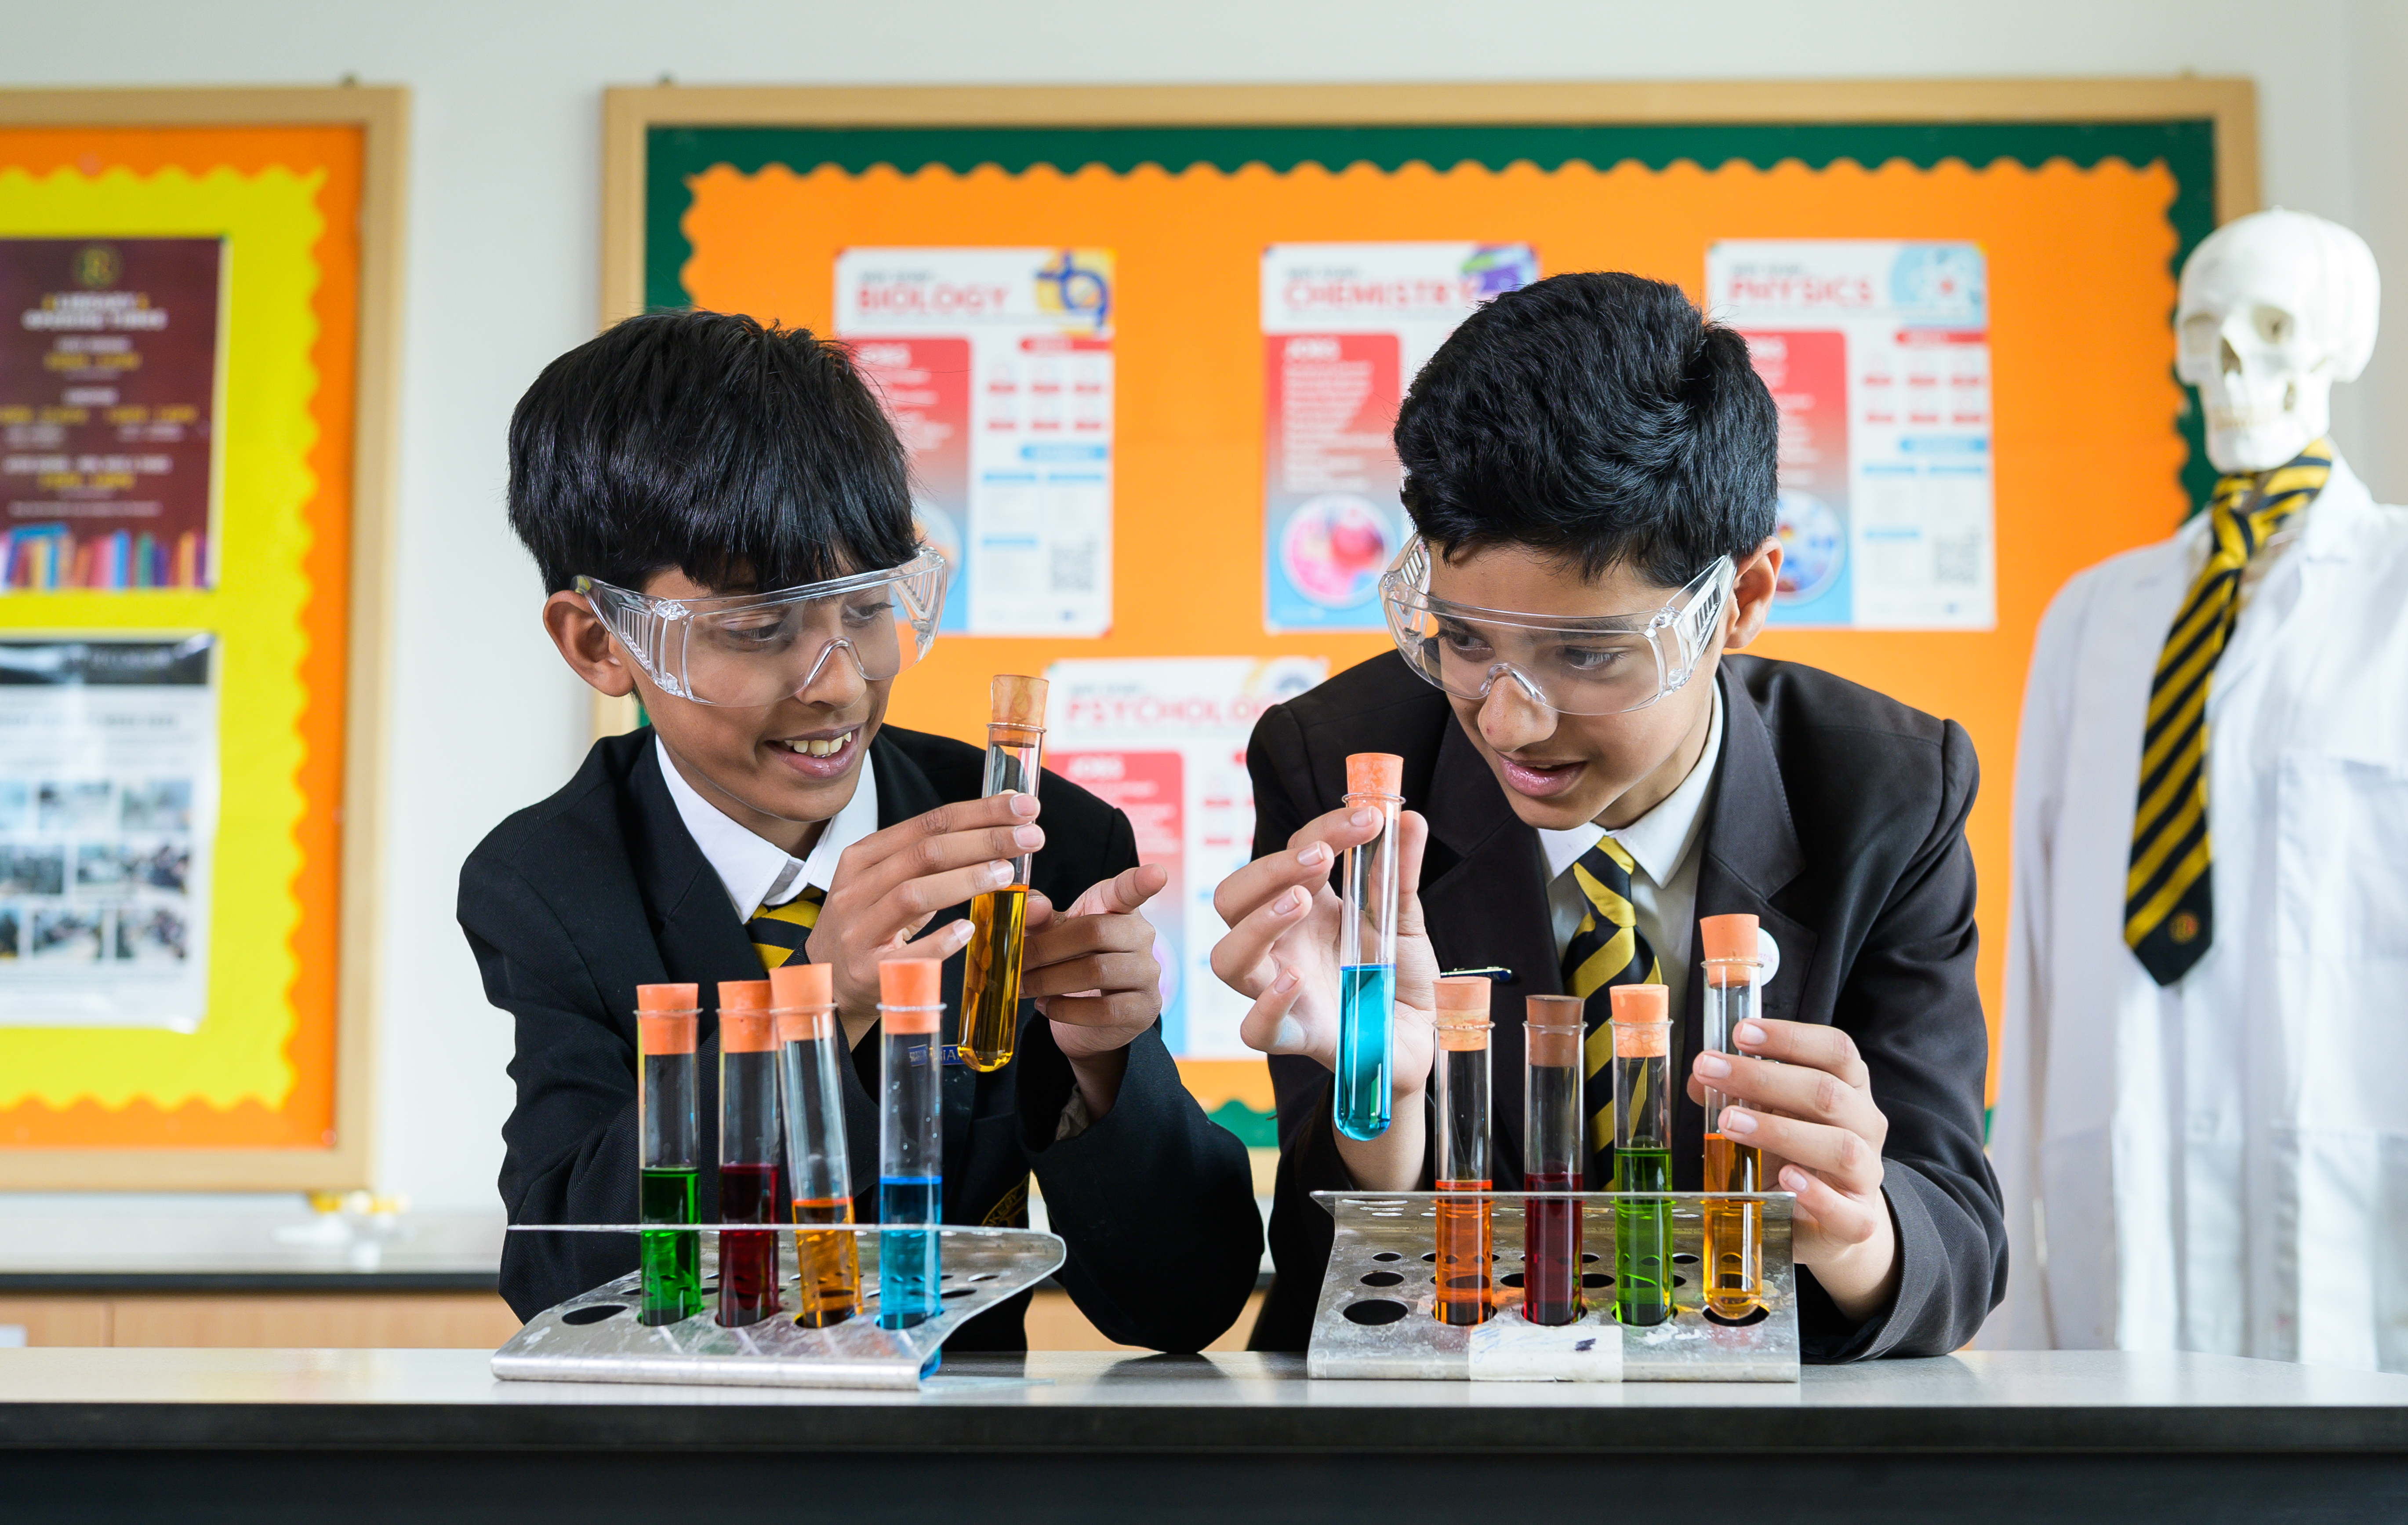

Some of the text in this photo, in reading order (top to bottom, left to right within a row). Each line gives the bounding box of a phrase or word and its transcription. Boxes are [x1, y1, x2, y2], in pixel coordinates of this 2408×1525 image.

[854, 282, 1010, 314] BIOLOGY
[1282, 277, 1479, 310] CHEMISTRY
[1727, 275, 1874, 307] PHYSICS
[1064, 694, 1274, 726] PSYCHOLO
